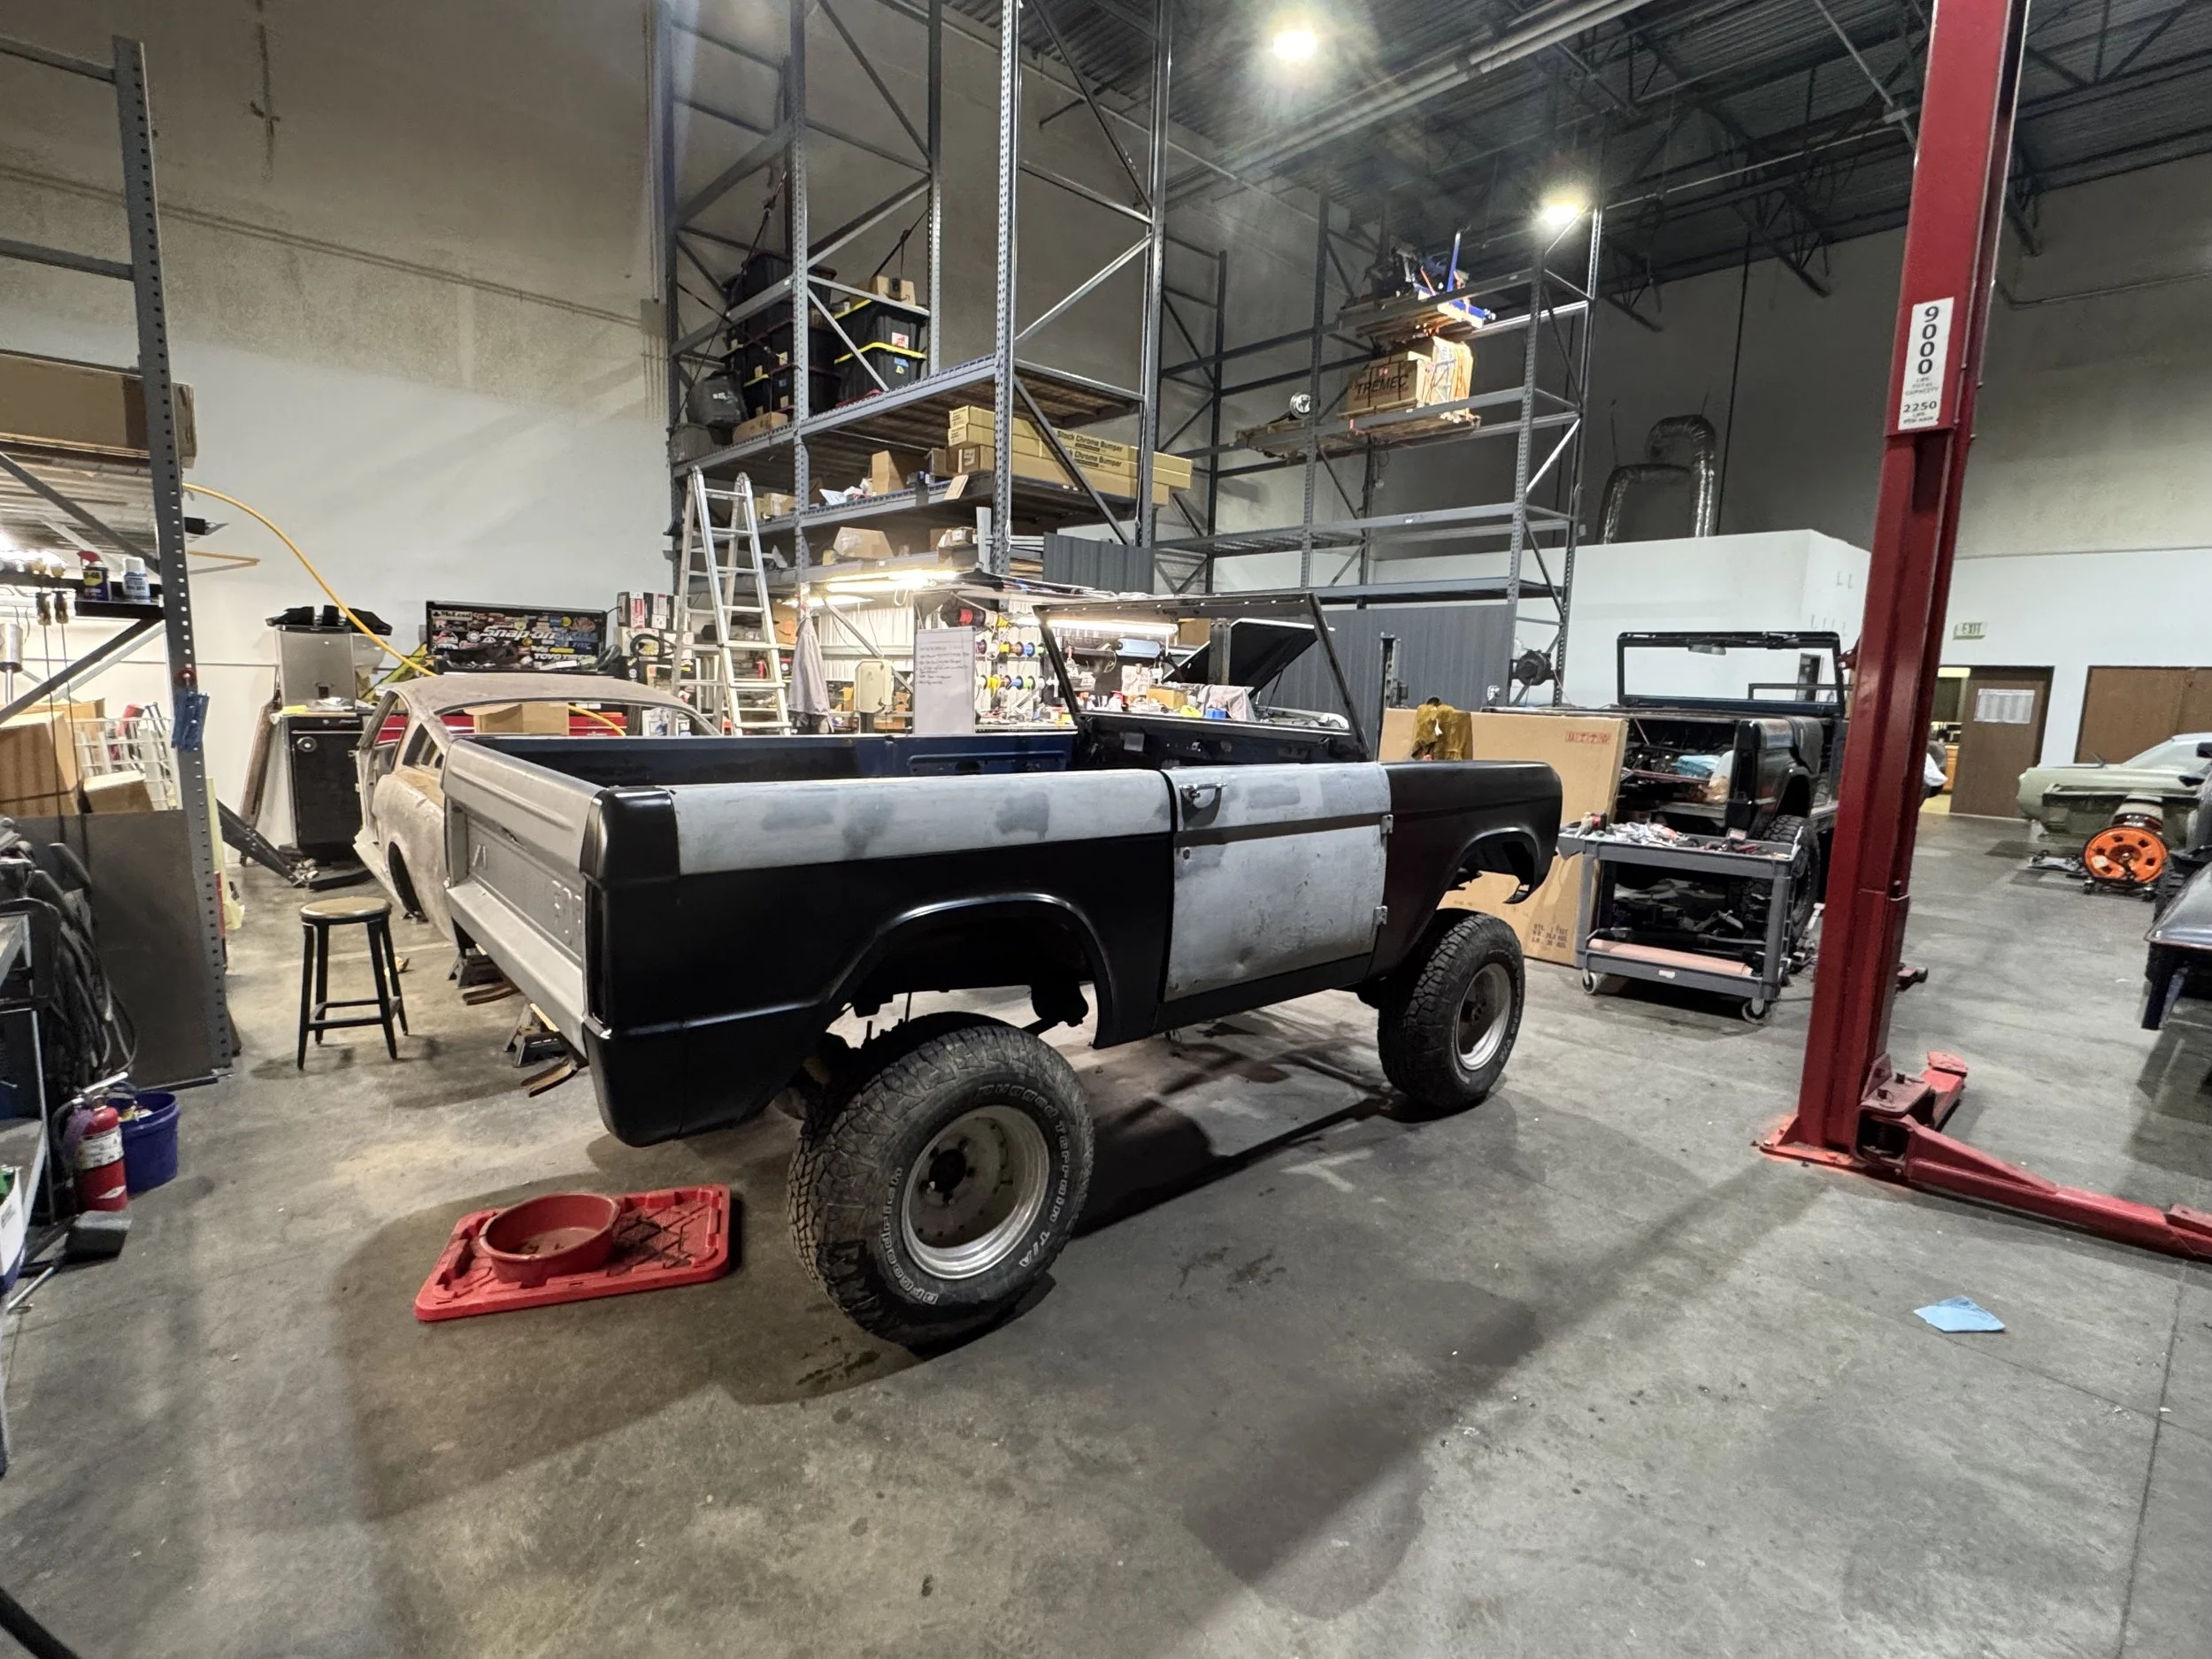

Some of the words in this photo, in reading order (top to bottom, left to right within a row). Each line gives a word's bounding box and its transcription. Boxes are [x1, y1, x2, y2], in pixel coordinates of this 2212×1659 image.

[1917, 305, 1939, 375] 9000
[1357, 373, 1409, 395] TREMEC
[1902, 401, 1938, 413] 2250
[1057, 430, 1075, 440] Stock
[1075, 434, 1100, 447] Chrome
[1100, 441, 1124, 453] Bumper
[1074, 450, 1098, 461] Chrome
[1099, 456, 1122, 467] Bumper
[1962, 622, 1983, 635] EXIT
[976, 1083, 1059, 1118] Rugged
[1048, 1120, 1071, 1223] Terrain
[1018, 1231, 1051, 1268] T/A
